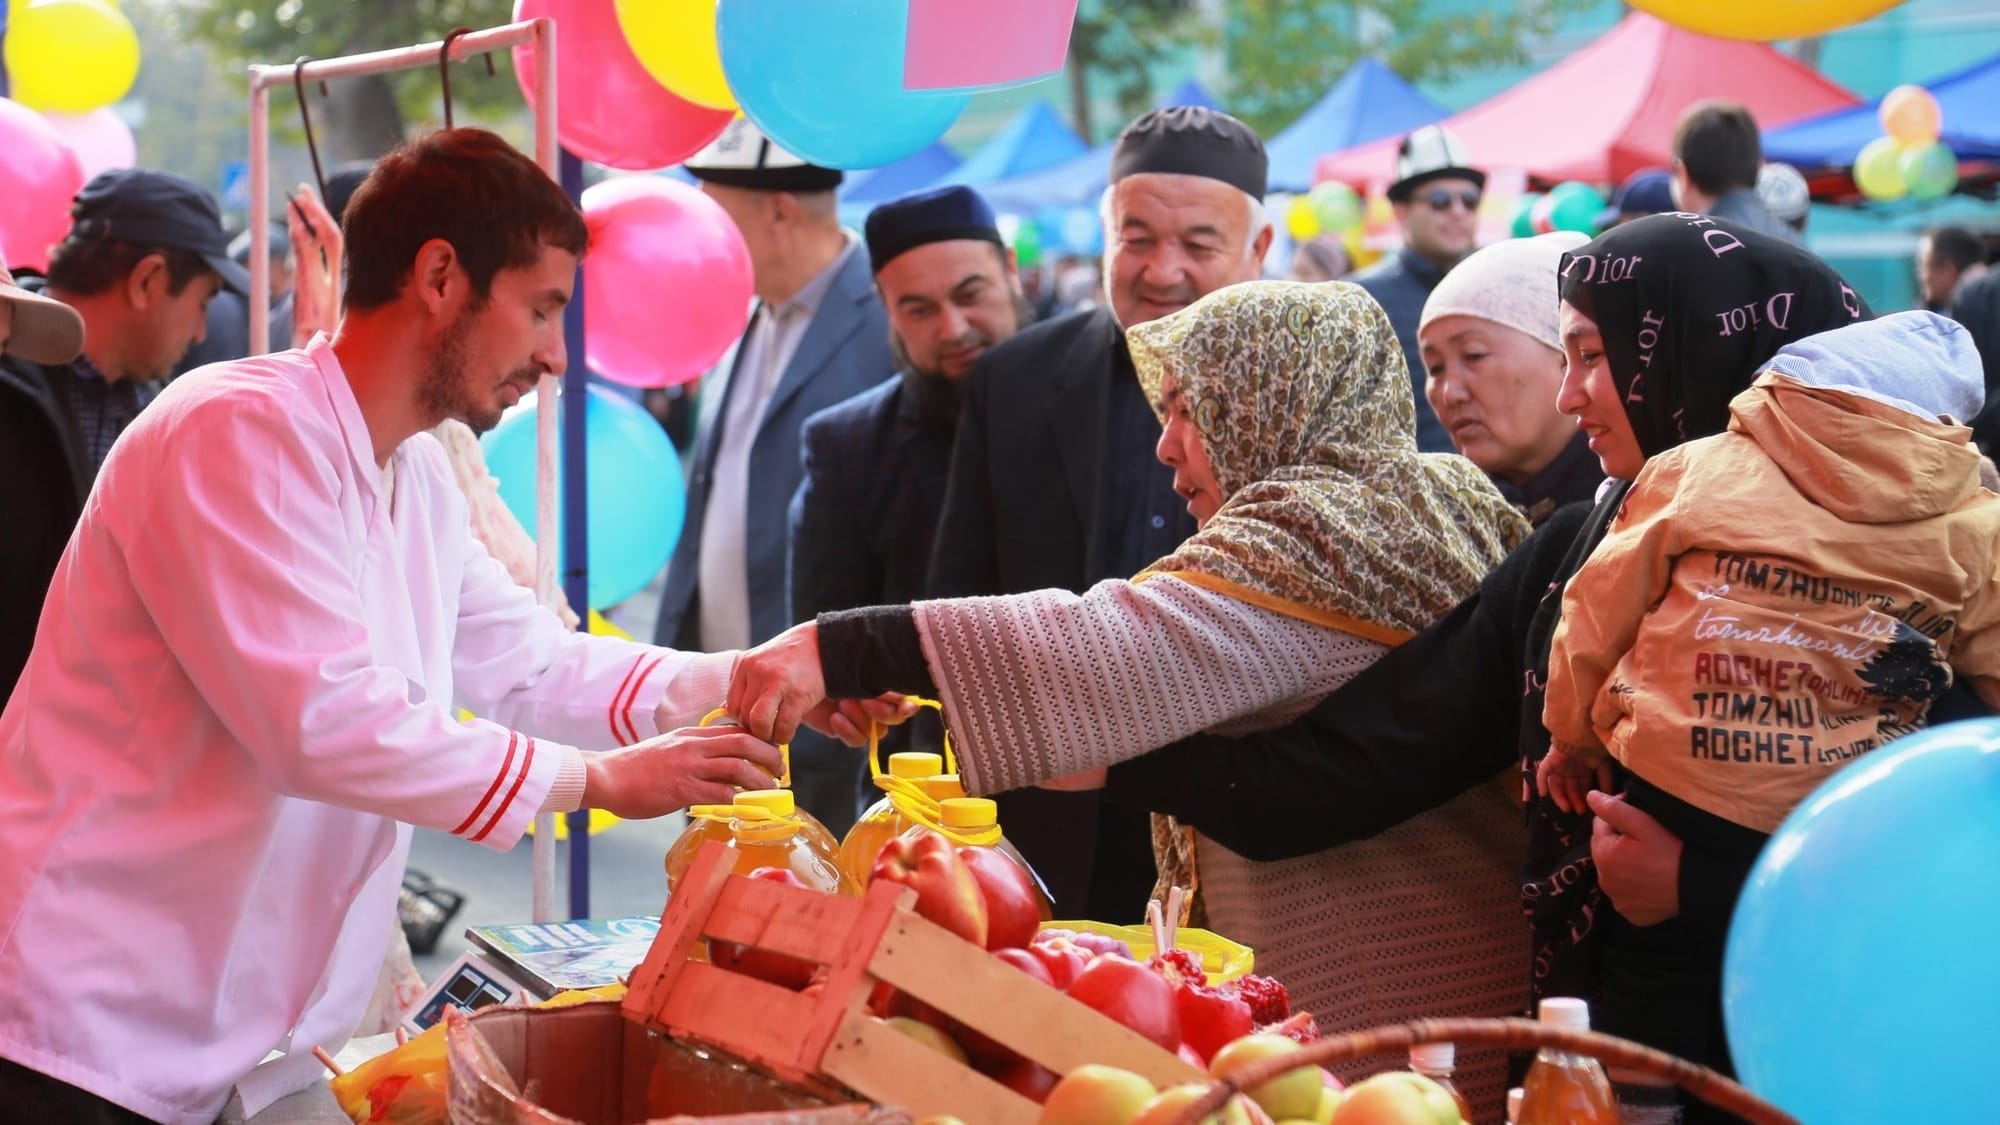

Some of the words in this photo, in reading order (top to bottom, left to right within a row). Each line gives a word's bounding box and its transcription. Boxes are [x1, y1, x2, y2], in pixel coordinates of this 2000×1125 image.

[1561, 253, 1643, 285] Dior
[1716, 292, 1795, 338] Dior
[1714, 552, 1832, 605] TOMZHU
[1695, 653, 1812, 692] ROCHET
[1692, 692, 1815, 730] TOMZHU
[1691, 726, 1814, 765] ROCHET
